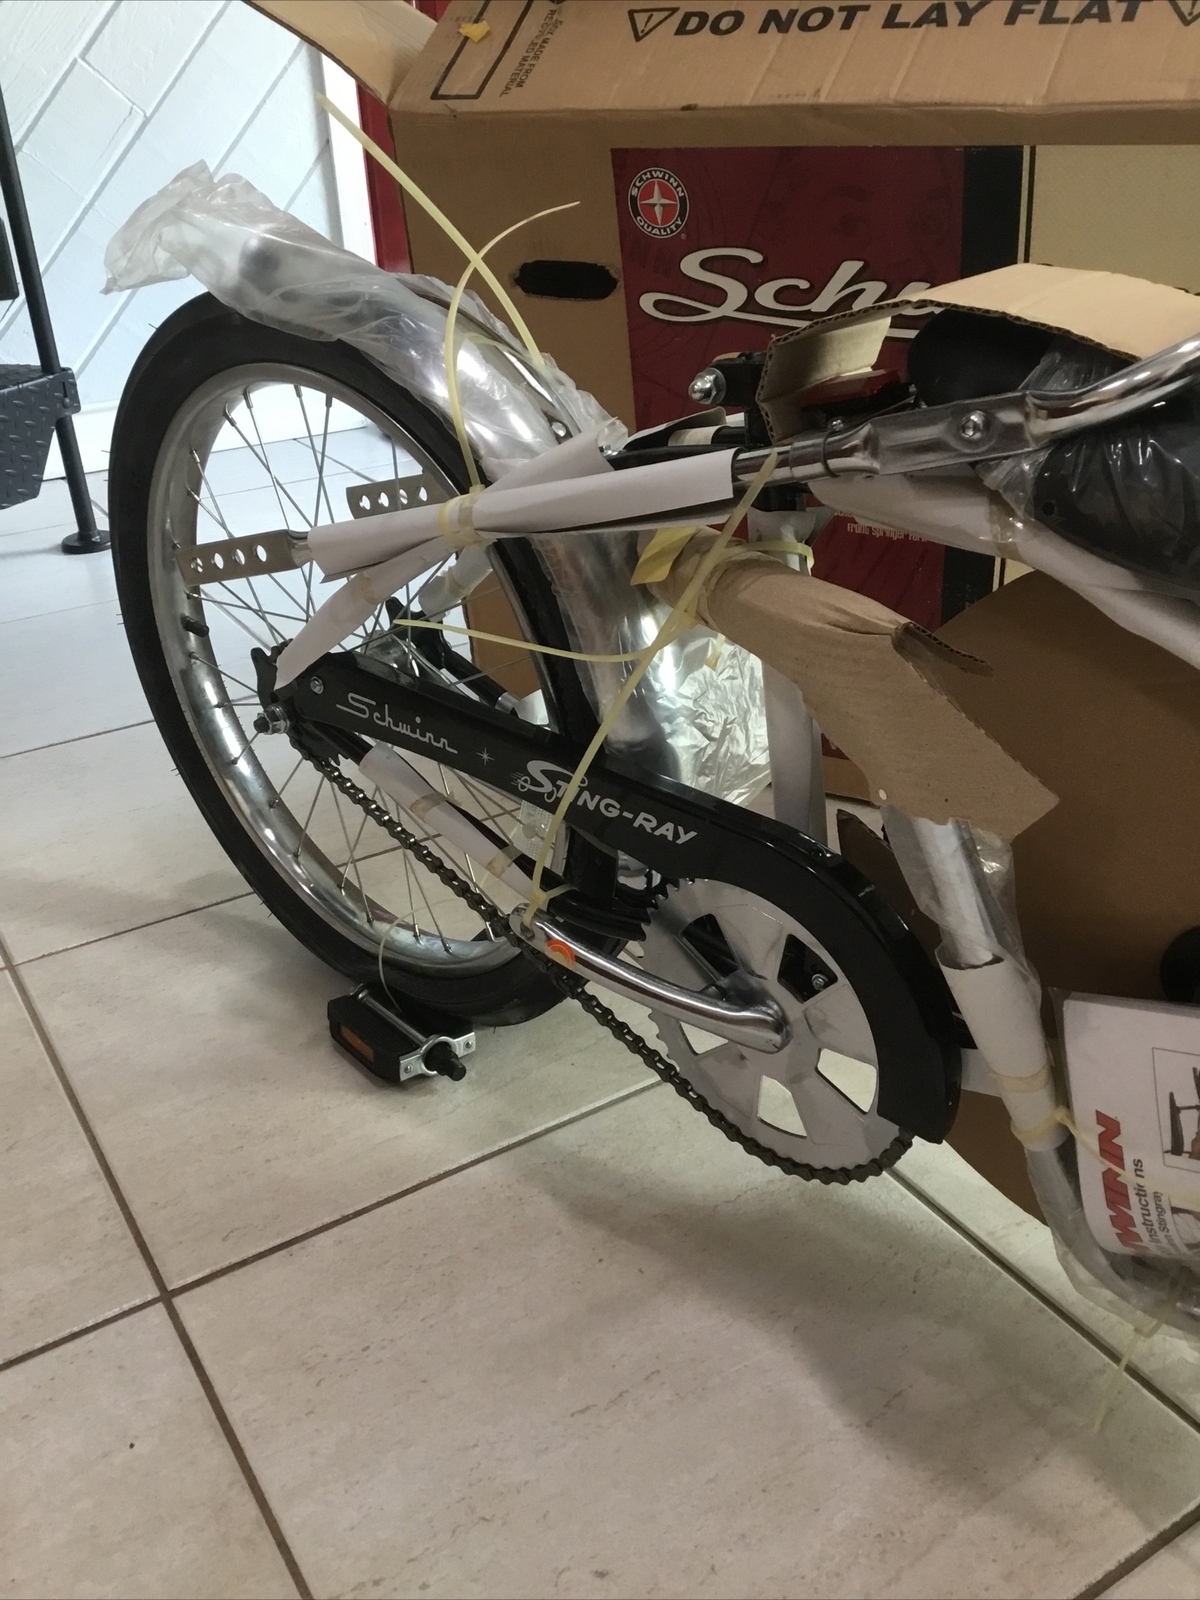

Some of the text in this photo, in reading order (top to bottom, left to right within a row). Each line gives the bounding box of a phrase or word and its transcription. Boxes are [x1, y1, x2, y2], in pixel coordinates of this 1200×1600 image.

[673, 1, 1145, 36] DO NOT LAY FLAT
[530, 37, 551, 62] MADE
[499, 55, 530, 97] MATERIAL
[514, 63, 536, 88] FROM
[631, 170, 685, 197] SCHWINN
[636, 215, 682, 235] QUALITY
[336, 692, 458, 755] Schwinn
